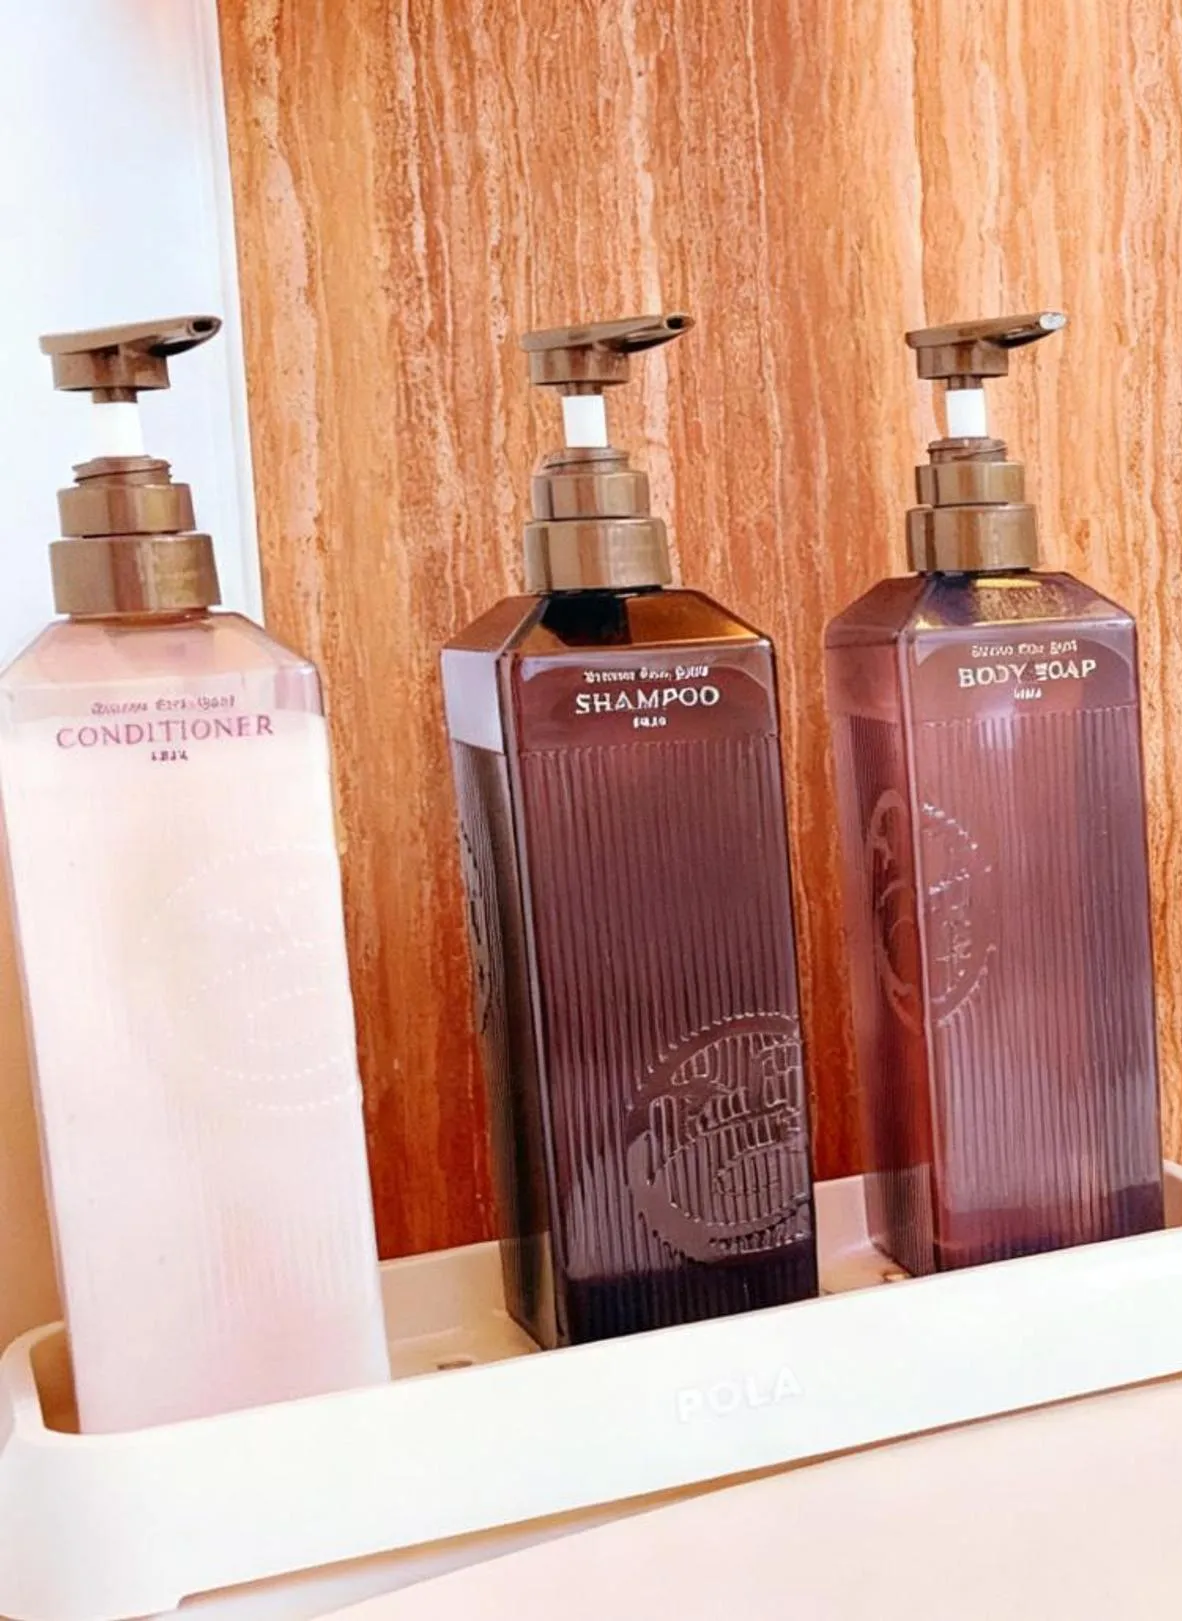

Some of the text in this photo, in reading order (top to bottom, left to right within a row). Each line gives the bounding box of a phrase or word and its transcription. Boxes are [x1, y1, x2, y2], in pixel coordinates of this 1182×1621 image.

[958, 664, 1027, 688] BODY
[575, 685, 720, 715] SHAMPOO
[56, 714, 274, 749] CONDITIONER
[675, 1363, 805, 1425] POLA
